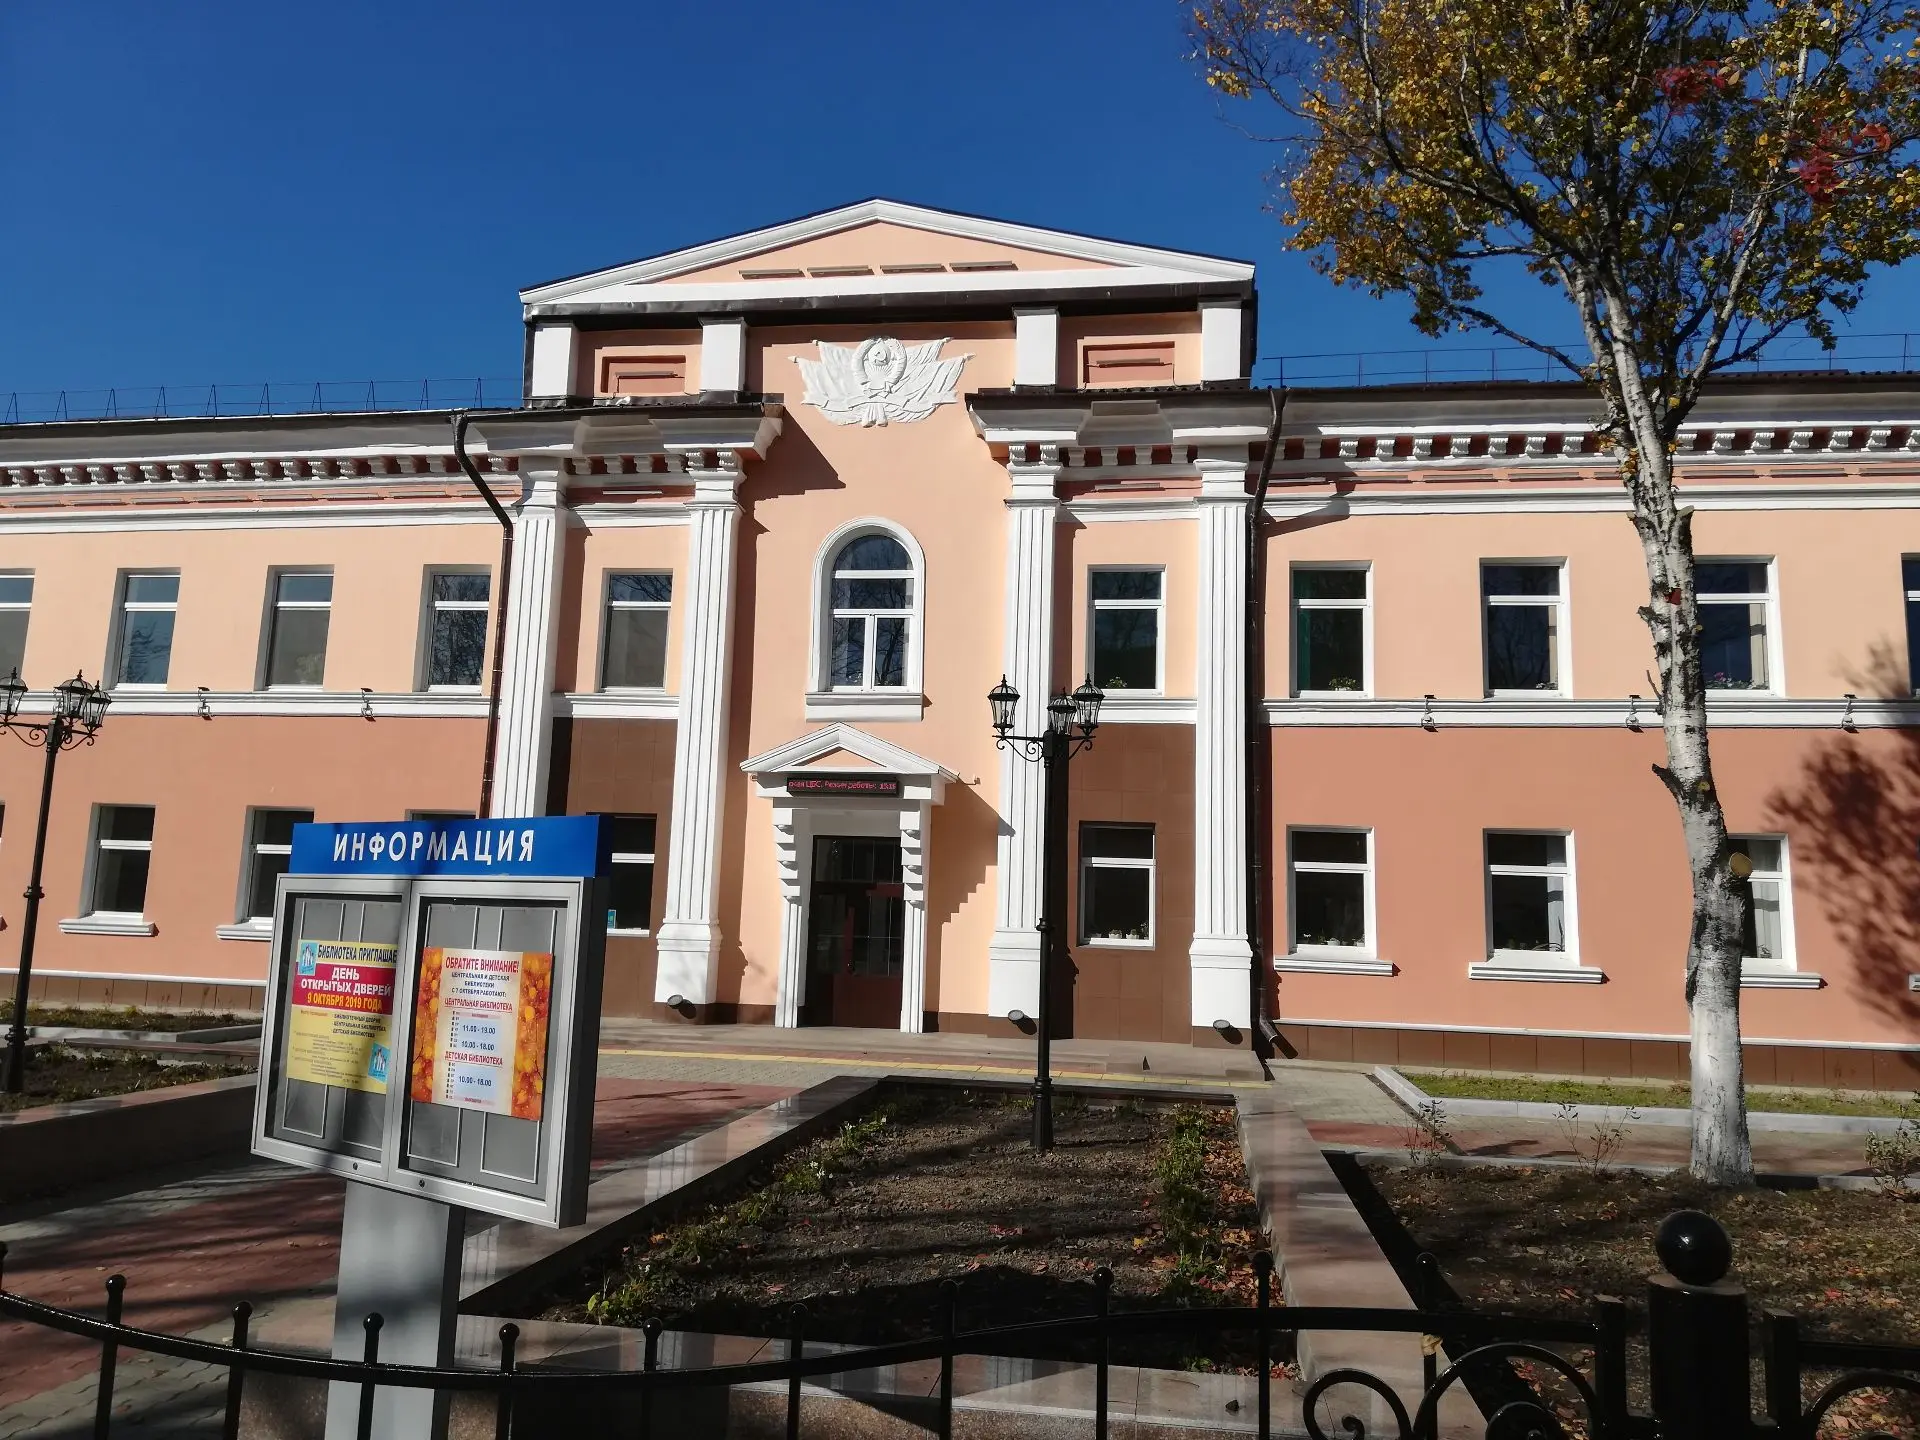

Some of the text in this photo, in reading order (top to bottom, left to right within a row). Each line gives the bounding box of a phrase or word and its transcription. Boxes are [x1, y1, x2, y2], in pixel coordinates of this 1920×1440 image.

[333, 829, 535, 865] ИНФОРМАЦИЯ
[318, 945, 357, 960] БИБЛИОТЕКА
[446, 956, 520, 974] ОБРАТИТЕ ВНИМАНИЕ!
[332, 967, 360, 981] ДЕНЬ
[452, 972, 484, 980] ЦЕНТРАЛЬНАЯ
[488, 974, 510, 982] ДЕТСКАЯ
[301, 978, 391, 997] ОТКРЫТЫХ ДВЕРЕЙ
[464, 981, 495, 989] БИБЛИОТЕКИ
[480, 990, 507, 998] РАБОТАЮТ:
[307, 992, 382, 1013] 9 ОКТЯБРЯ 2019 ГОДА
[445, 998, 513, 1011] ЦЕНТРАЛЬНАЯ БИБЛИОТЕКА
[480, 1042, 495, 1051] 18.00
[445, 1051, 503, 1065] ДЕТСКАЯ БИБЛИОТЕКА
